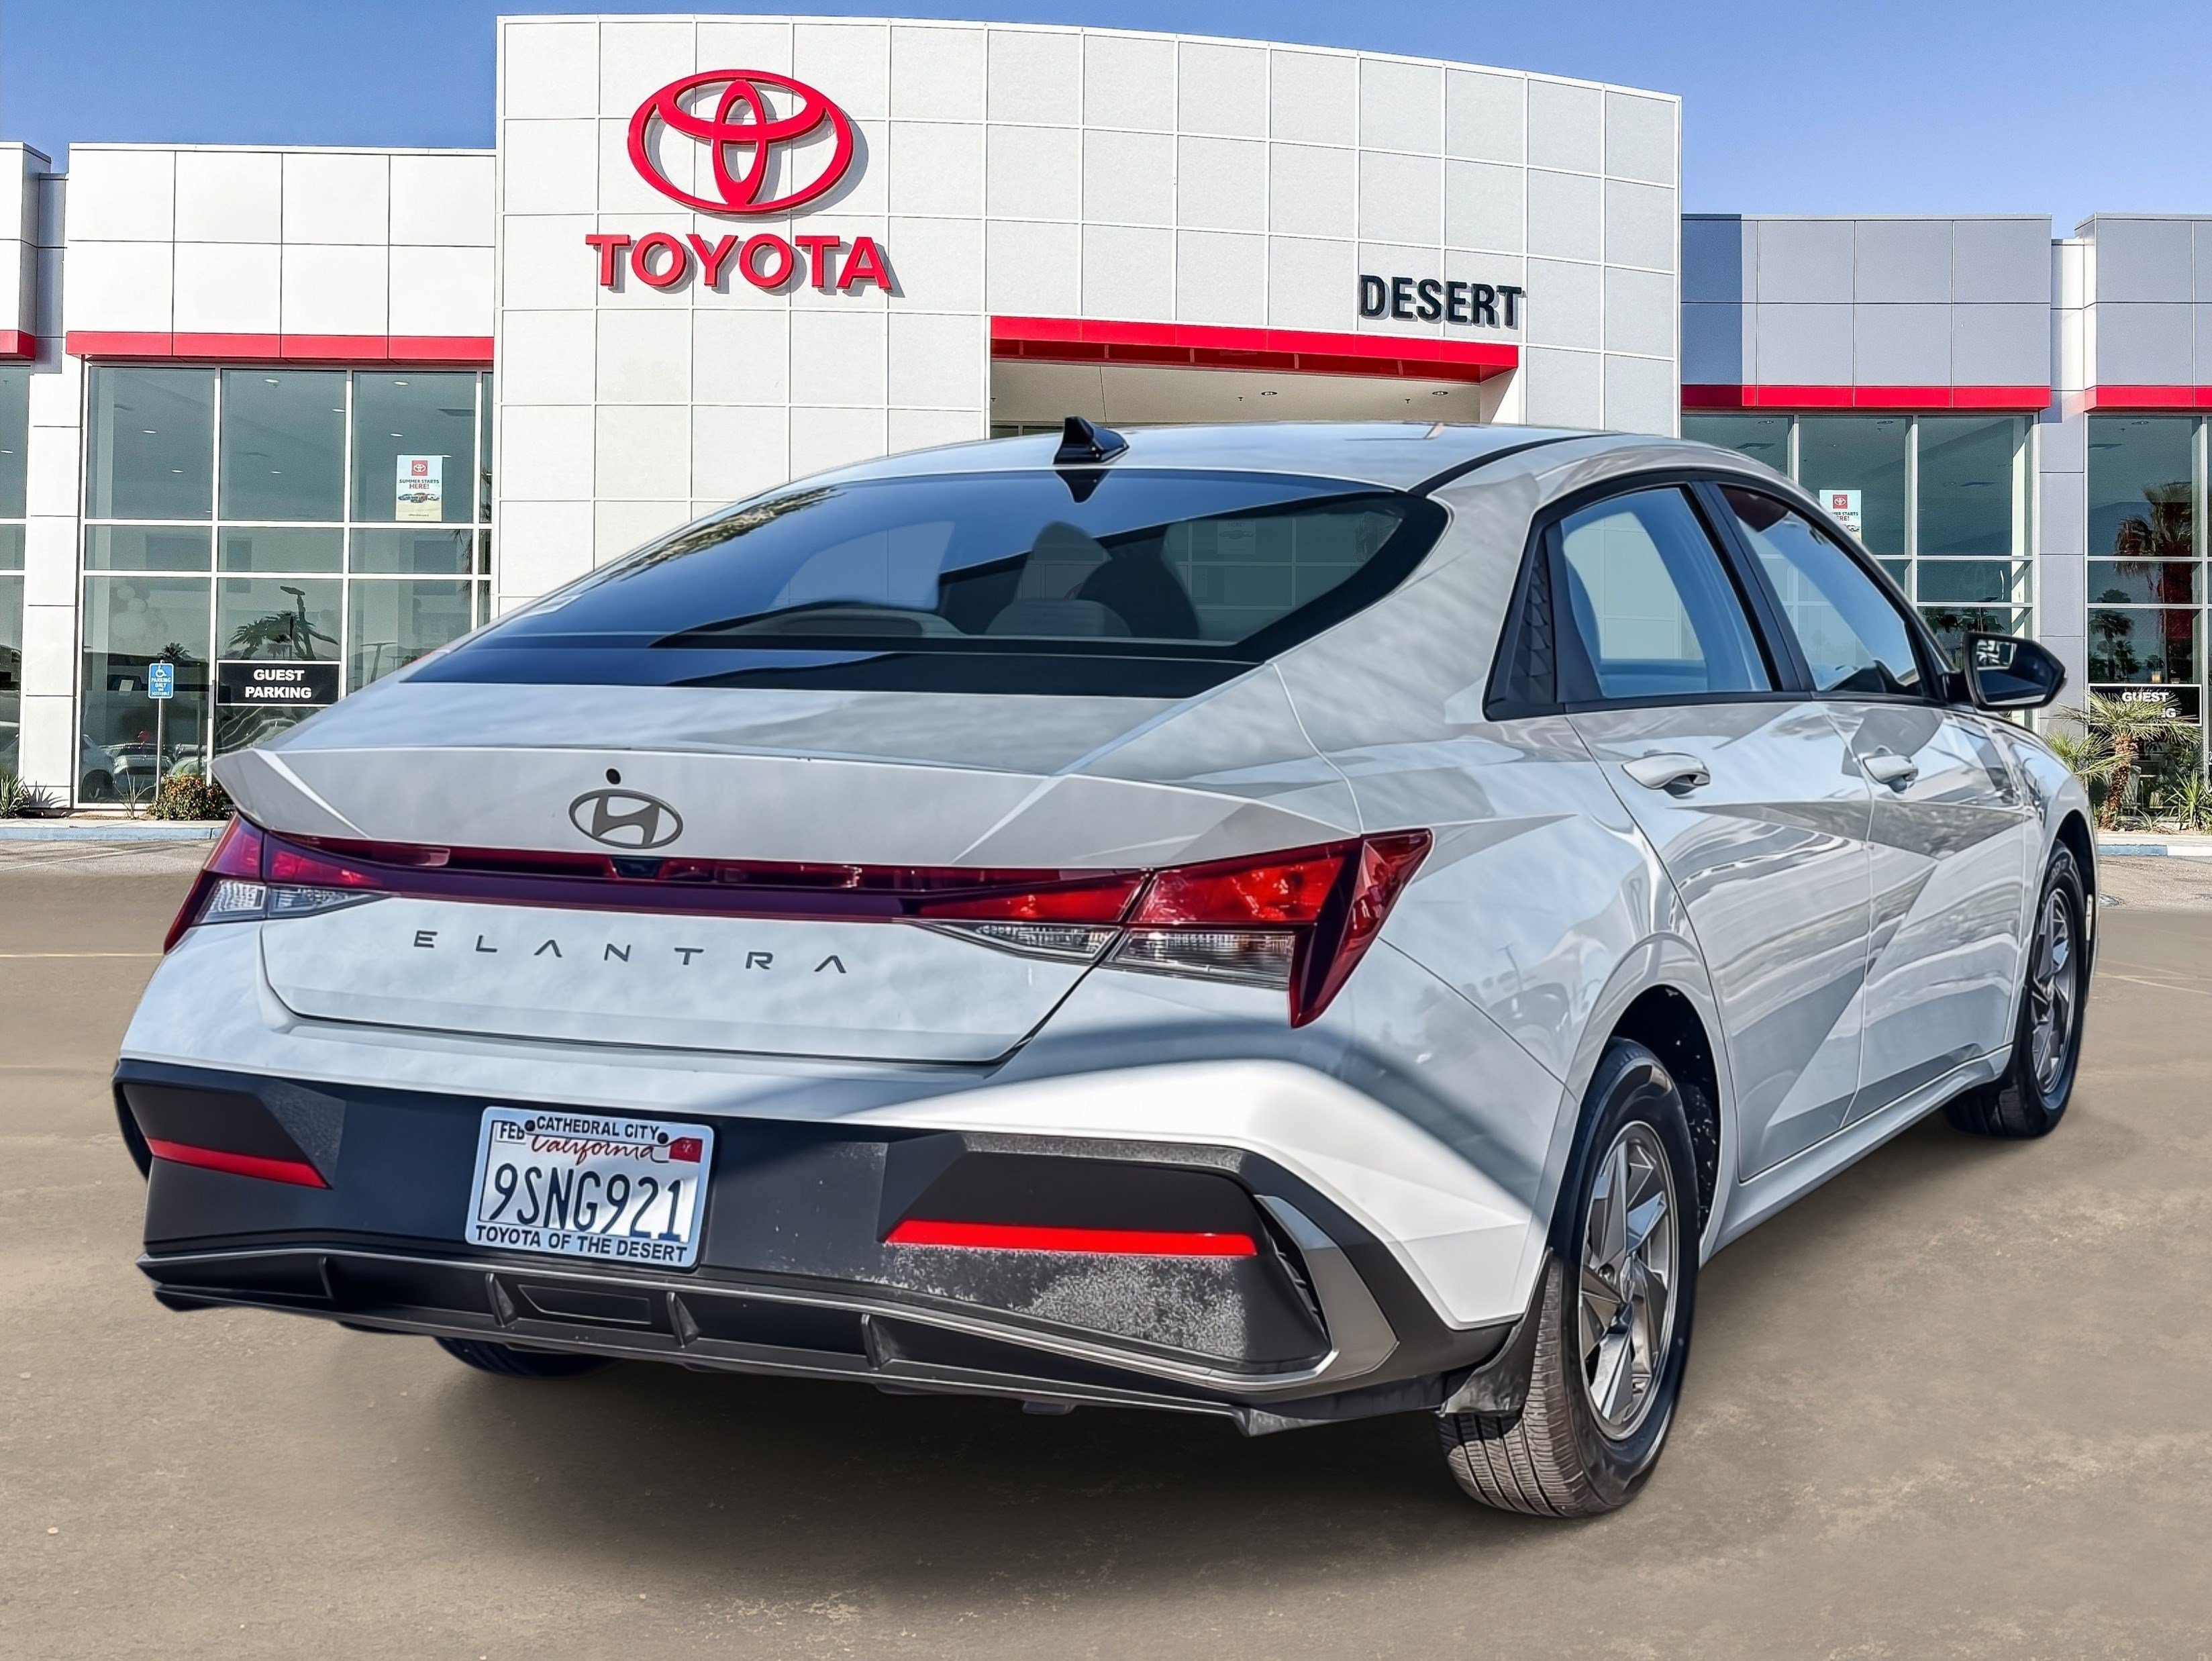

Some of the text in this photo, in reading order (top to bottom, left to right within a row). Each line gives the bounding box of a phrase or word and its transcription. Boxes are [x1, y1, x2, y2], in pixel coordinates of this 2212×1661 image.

[585, 232, 892, 291] TOYOTA
[1359, 274, 1522, 327] DESERT
[253, 668, 305, 681] GUEST
[245, 686, 312, 699] PARKING
[2121, 691, 2170, 703] GUEST
[413, 929, 847, 974] ELANTRA
[536, 1115, 660, 1140] CATHEDRAL CITY
[530, 1134, 670, 1166] California
[489, 1162, 683, 1242] 9SNG921
[475, 1225, 688, 1262] TOYOTA OF THE DESERT
